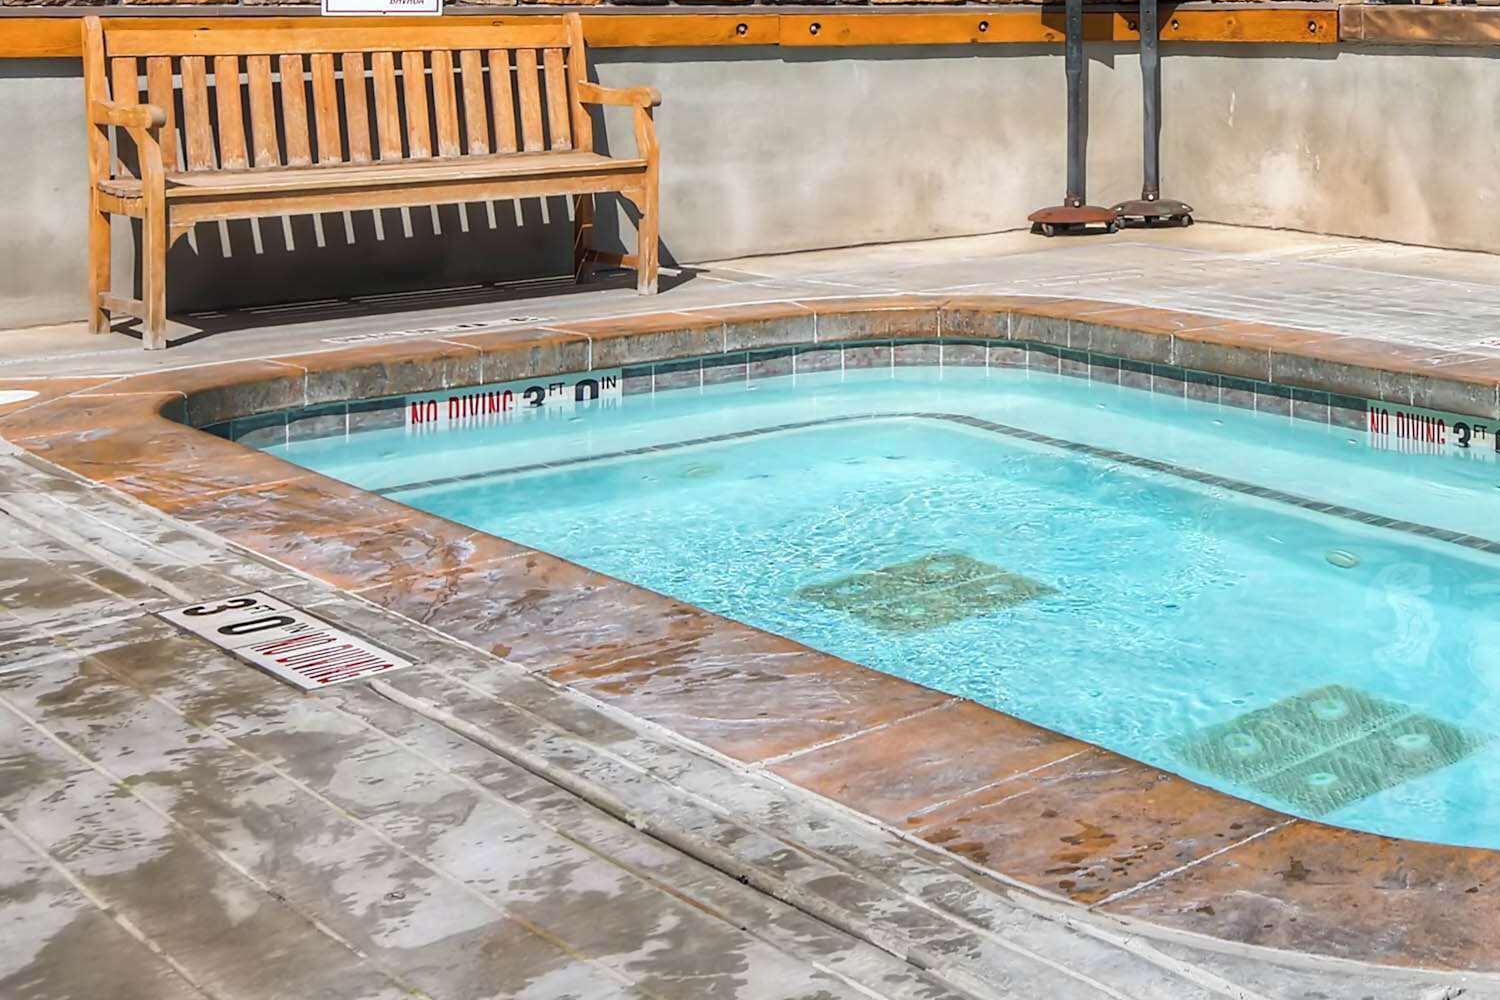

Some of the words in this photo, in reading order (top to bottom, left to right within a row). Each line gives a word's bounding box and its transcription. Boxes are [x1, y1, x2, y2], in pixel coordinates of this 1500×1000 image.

[411, 399, 438, 424] NO
[523, 385, 546, 408] 3
[549, 382, 565, 397] FT
[601, 375, 617, 390] IN
[1369, 406, 1389, 436] NO
[1396, 411, 1446, 445] DIVING
[1453, 421, 1472, 448] 3
[1473, 424, 1488, 440] FT
[182, 598, 258, 617] 3
[217, 615, 297, 636] 0
